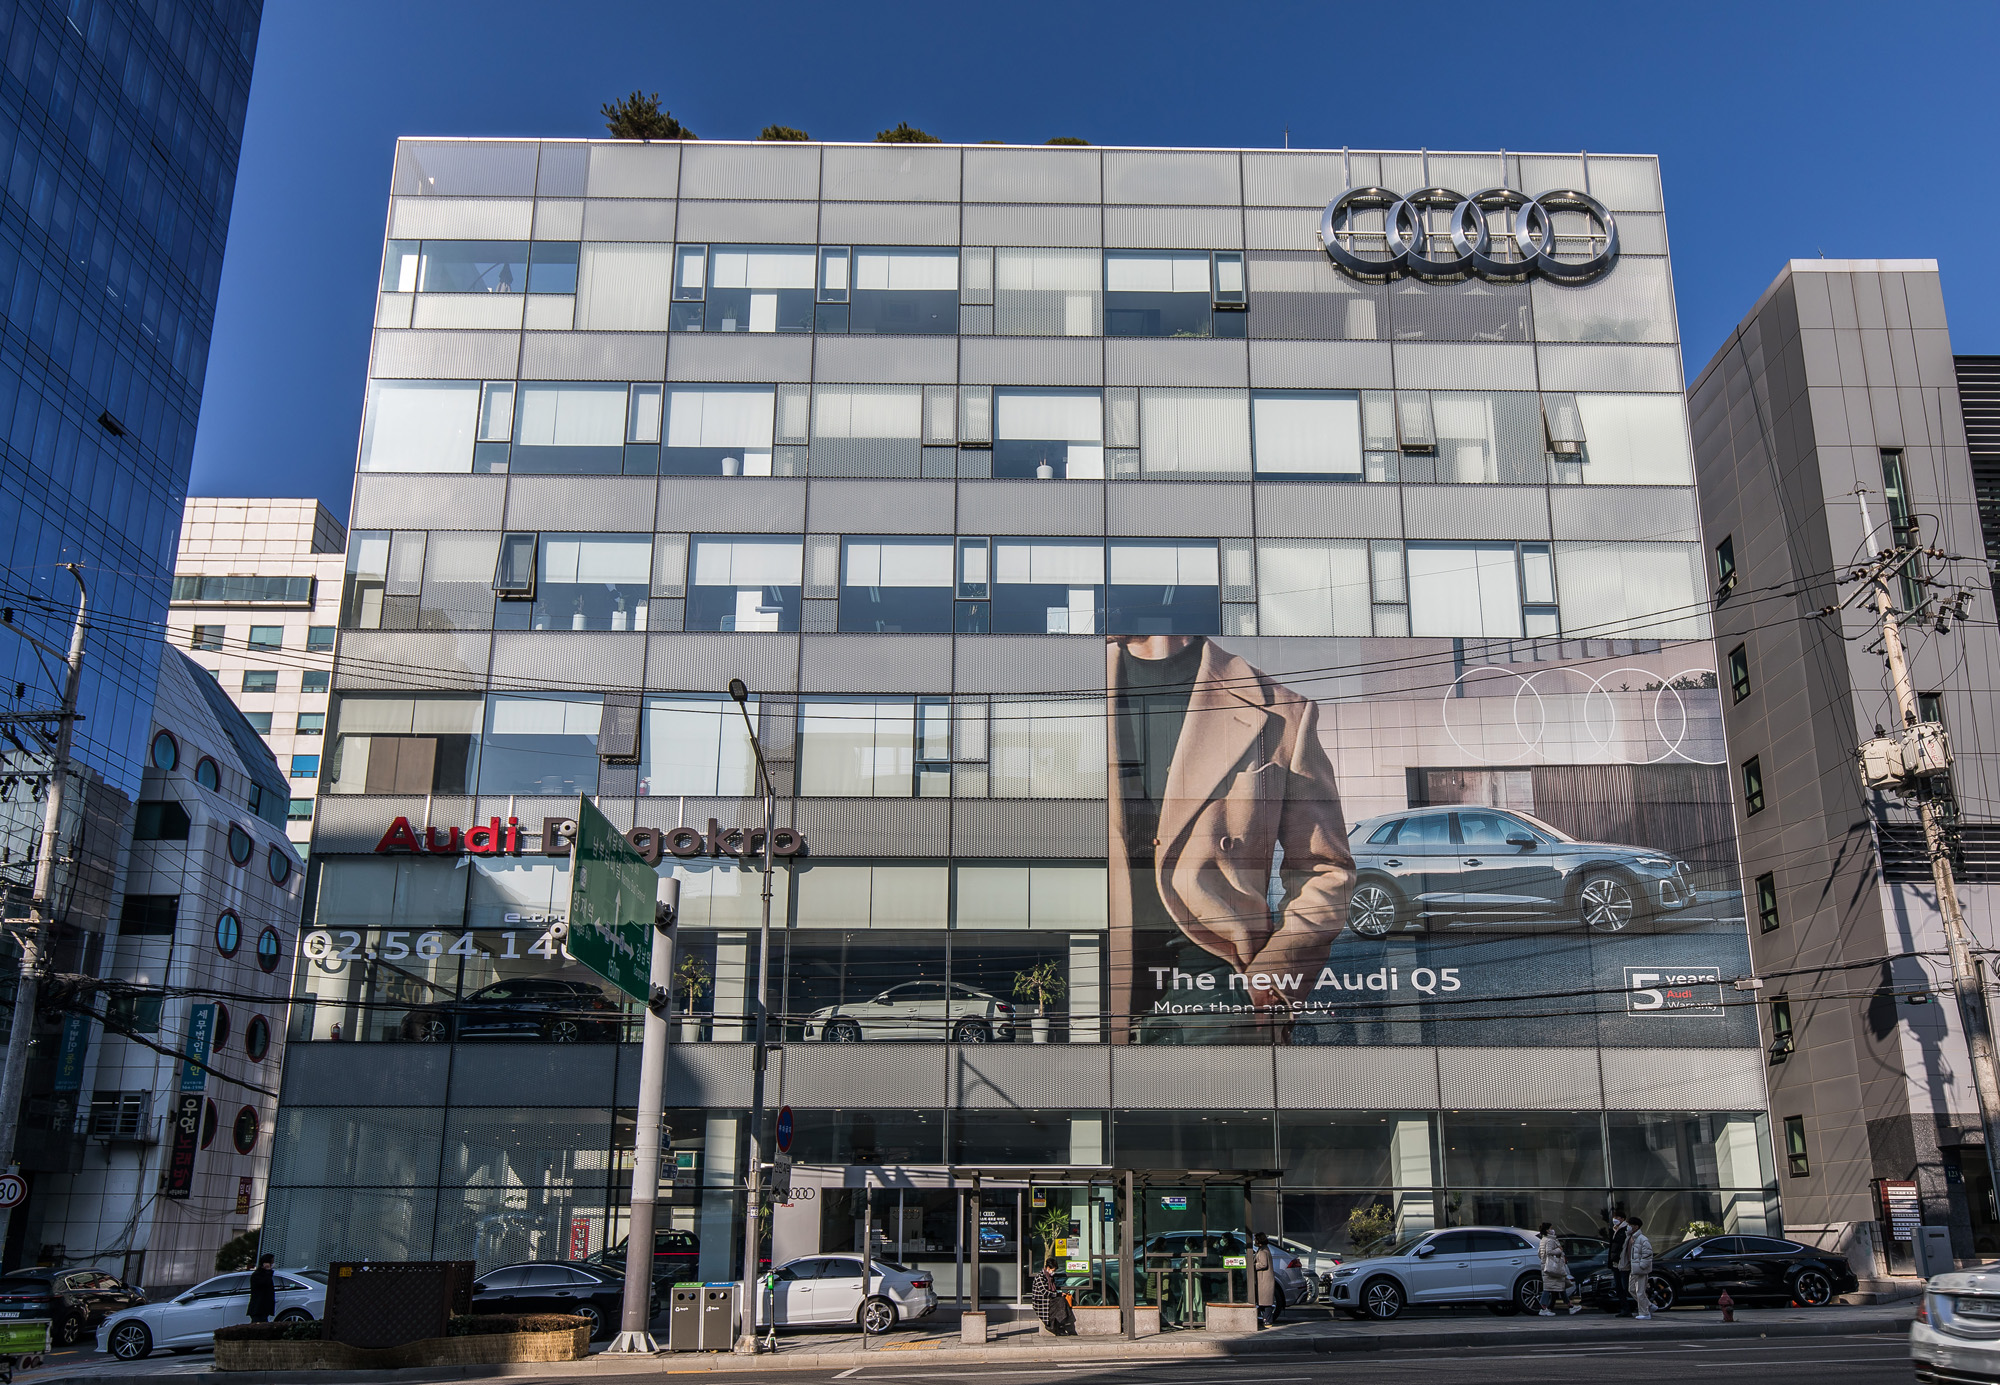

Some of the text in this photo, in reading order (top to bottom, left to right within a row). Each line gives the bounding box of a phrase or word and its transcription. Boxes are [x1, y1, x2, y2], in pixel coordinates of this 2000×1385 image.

[374, 816, 803, 863] Audi Dgokro
[606, 825, 623, 858] 사당역
[592, 836, 622, 880] 남부터미널
[573, 890, 594, 924] 양재역
[636, 943, 651, 969] 강남역
[1148, 966, 1462, 993] The new Audi Q5
[1632, 973, 1664, 1010] 5
[1665, 973, 1716, 986] years
[1667, 989, 1692, 998] Audi
[1667, 1001, 1718, 1012] Warranty
[1154, 1000, 1204, 1015] More
[1209, 1001, 1256, 1015] than
[1263, 1004, 1286, 1016] an
